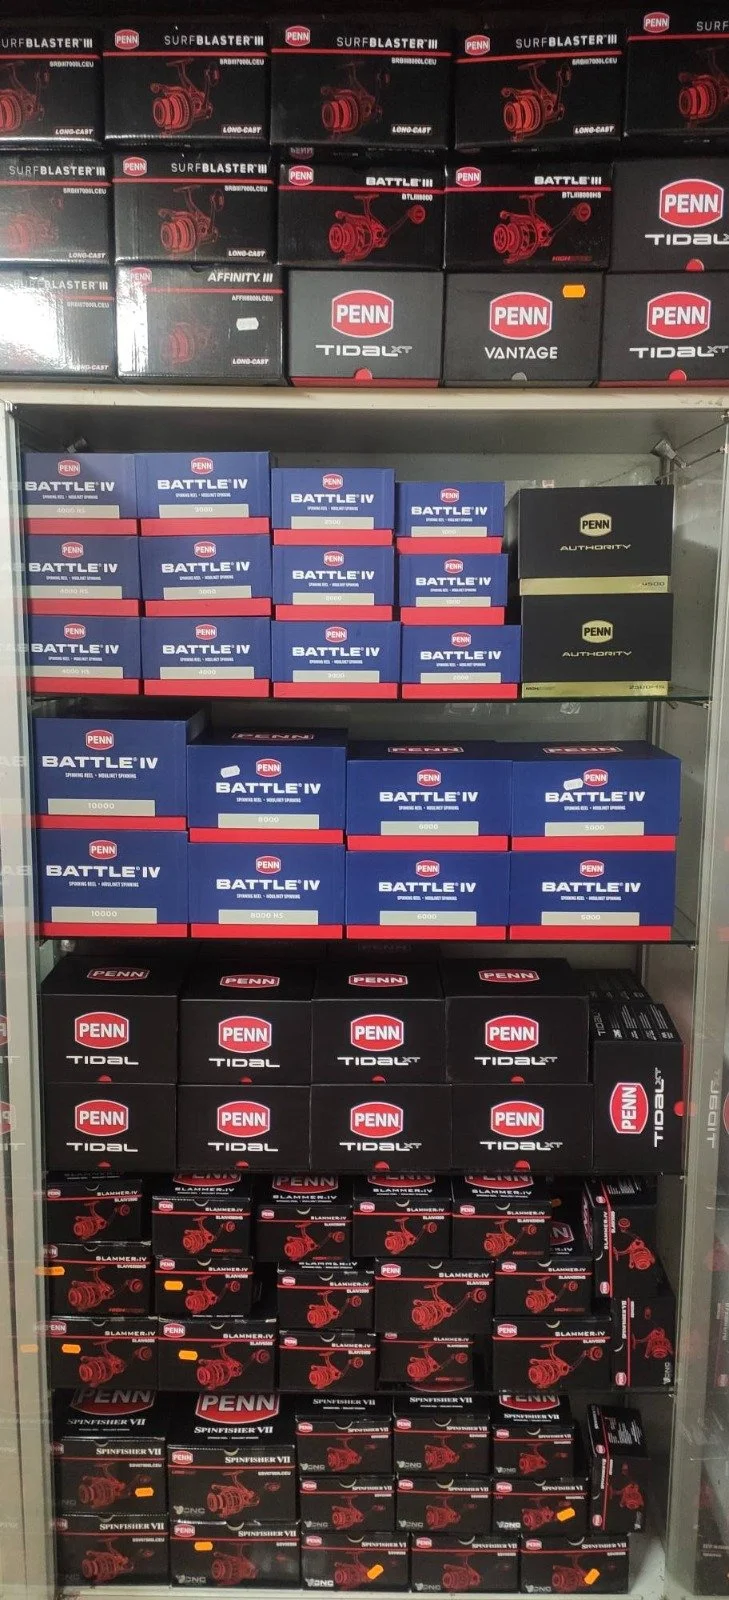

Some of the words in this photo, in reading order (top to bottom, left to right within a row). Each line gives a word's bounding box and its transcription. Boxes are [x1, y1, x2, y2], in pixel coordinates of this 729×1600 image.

[645, 18, 669, 27] PENN
[116, 35, 139, 45] PENN
[164, 35, 250, 46] SURFBLASTER
[254, 36, 264, 46] III
[286, 32, 310, 41] PENN
[515, 36, 603, 49] SURFBLASTER
[608, 34, 617, 45] III
[84, 38, 93, 48] III
[336, 37, 424, 49] SURFBLASTER
[428, 39, 438, 50] III
[466, 40, 490, 50] PENN
[55, 128, 94, 136] LONG-CAST
[223, 126, 262, 134] LONG-CAST
[392, 126, 432, 134] LONG-CAST
[574, 126, 614, 135] LONG-CAST
[8, 165, 92, 176] SURFBLASTER
[96, 167, 106, 176] III
[124, 162, 146, 172] PENN
[171, 163, 254, 174] SURFBLASTER
[258, 164, 267, 174] III
[290, 171, 313, 181] PENN
[457, 172, 480, 181] PENN
[534, 176, 587, 186] BATTLE
[591, 176, 602, 185] III
[366, 177, 418, 187] BATTLE
[422, 178, 433, 187] III
[664, 193, 720, 214] PENN
[99, 281, 108, 290] III
[336, 304, 391, 325] PENN
[495, 306, 549, 326] PENN
[652, 305, 708, 326] PENN
[484, 346, 558, 360] VANTAGE
[232, 358, 269, 366] LONG-CAST
[58, 464, 80, 472] PENN
[191, 462, 212, 470] PENN
[24, 481, 95, 492] BATTLE
[100, 482, 115, 492] IV
[158, 479, 228, 490] BATTLE
[233, 479, 248, 490] IV
[323, 478, 342, 487] PENN
[291, 494, 357, 504] BATTLE
[361, 494, 374, 504] IV
[411, 507, 471, 516] BATTLE
[475, 507, 488, 516] IV
[582, 520, 610, 530] PENN
[62, 546, 83, 554] PENN
[195, 546, 216, 554] PENN
[324, 555, 343, 563] PENN
[29, 563, 99, 573] BATTLE
[103, 563, 118, 573] IV
[162, 562, 231, 573] BATTLE
[236, 562, 250, 572] IV
[445, 562, 463, 570] PENN
[292, 571, 357, 580] BATTLE
[361, 571, 374, 580] IV
[415, 577, 474, 586] BATTLE
[479, 577, 491, 586] IV
[65, 628, 86, 636] PENN
[196, 628, 217, 636] PENN
[326, 631, 346, 639] PENN
[584, 627, 611, 636] PENN
[451, 636, 471, 644] PENN
[31, 644, 100, 654] BATTLE
[105, 644, 120, 654] IV
[163, 645, 231, 654] BATTLE
[236, 644, 250, 654] IV
[292, 647, 361, 657] BATTLE
[365, 647, 380, 657] IV
[420, 651, 484, 660] BATTLE
[488, 651, 502, 660] IV
[87, 736, 113, 745] PENN
[42, 756, 133, 768] BATTLE
[140, 757, 158, 769] IV
[257, 764, 280, 773] PENN
[418, 774, 440, 783] PENN
[585, 774, 607, 783] PENN
[216, 783, 298, 794] BATTLE
[304, 783, 321, 794] IV
[380, 792, 457, 802] BATTLE
[462, 792, 478, 802] IV
[545, 792, 624, 803] BATTLE
[630, 791, 646, 802] IV
[91, 846, 116, 855] PENN
[257, 861, 280, 870] PENN
[417, 865, 439, 874] PENN
[582, 865, 603, 873] PENN
[46, 865, 136, 877] BATTLE
[142, 866, 160, 878] IV
[216, 879, 297, 890] BATTLE
[303, 880, 321, 891] IV
[378, 882, 456, 893] BATTLE
[460, 882, 477, 893] IV
[542, 882, 619, 893] BATTLE
[625, 882, 641, 893] IV
[225, 977, 276, 985] PENN
[79, 1023, 125, 1038] PENN
[223, 1027, 268, 1043] PENN
[355, 1025, 400, 1041] PENN
[489, 1026, 535, 1042] PENN
[621, 1087, 637, 1130] PENN
[79, 1111, 125, 1126] PENN
[222, 1112, 268, 1127] PENN
[355, 1113, 400, 1128] PENN
[495, 1112, 541, 1127] PENN
[382, 1266, 401, 1275] PENN
[164, 1327, 185, 1335] PENN
[498, 1327, 517, 1335] PENN
[202, 1394, 275, 1411] PENN
[130, 1418, 146, 1426] VII
[194, 1426, 256, 1434] SPINFISHER
[257, 1426, 273, 1434] VII
[96, 1448, 147, 1456] SPINFISHER
[148, 1448, 161, 1456] VII
[172, 1454, 193, 1462] PENN
[100, 1523, 150, 1531] SPINFISHER
[174, 1527, 195, 1535] PENN
